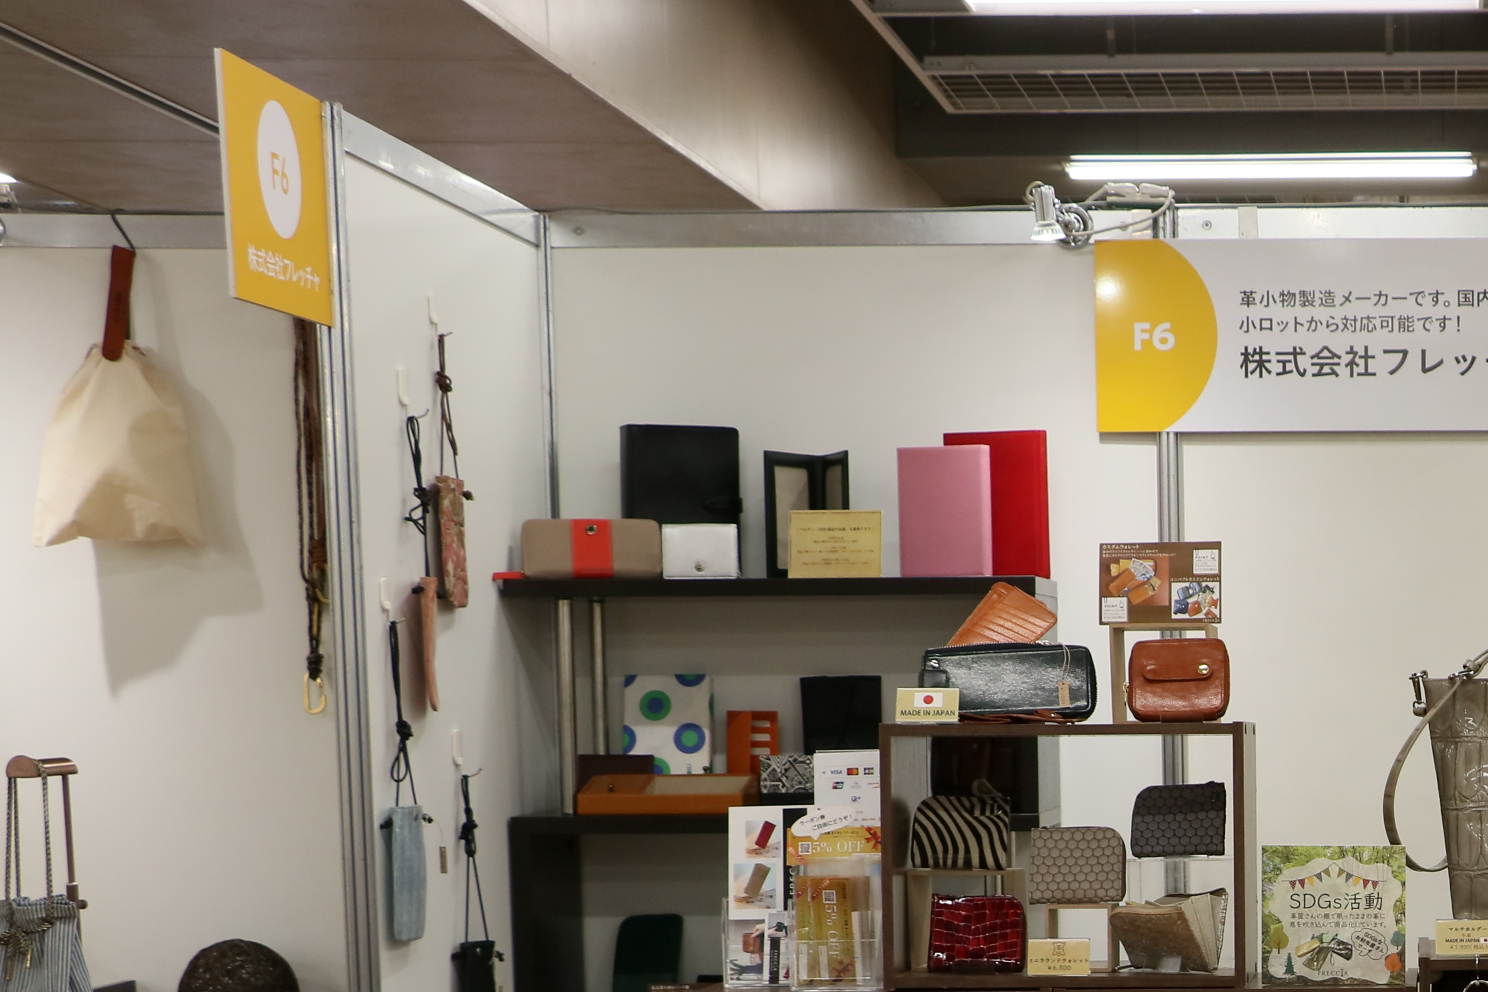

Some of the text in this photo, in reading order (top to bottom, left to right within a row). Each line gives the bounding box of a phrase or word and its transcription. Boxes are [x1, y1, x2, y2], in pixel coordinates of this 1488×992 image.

[270, 150, 290, 196] F6
[247, 244, 321, 292] 株式会社フレッチャ
[1133, 321, 1176, 352] F6
[812, 840, 865, 853] 5% OFF
[1290, 892, 1383, 910] SDGs活動
[825, 905, 838, 925] 5%
[1317, 969, 1348, 977] FRECCIA
